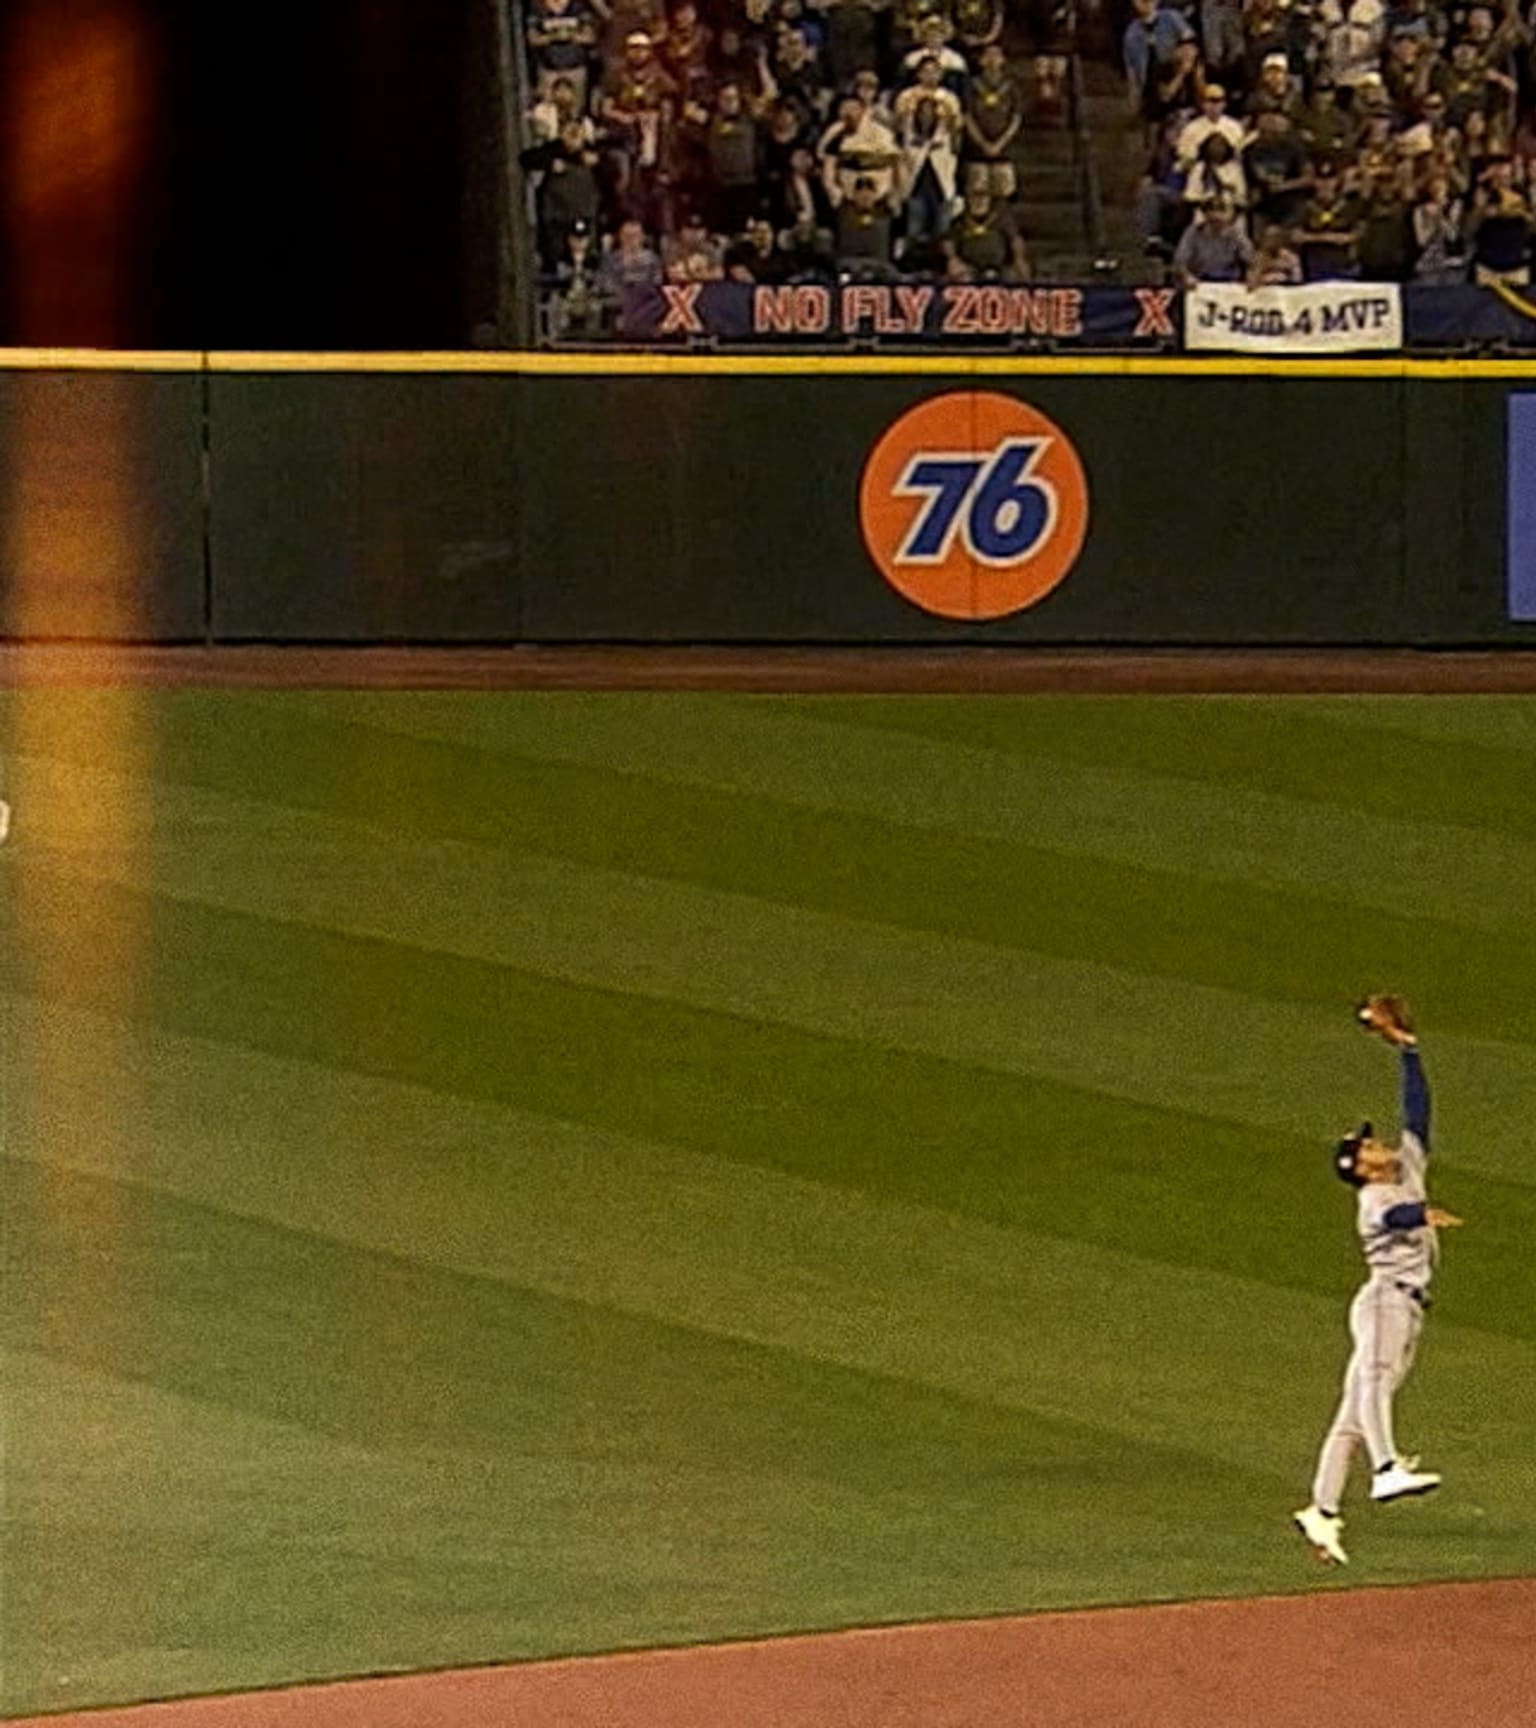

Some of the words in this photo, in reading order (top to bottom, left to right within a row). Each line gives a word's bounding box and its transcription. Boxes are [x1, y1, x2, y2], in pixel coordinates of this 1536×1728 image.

[661, 285, 702, 333] X
[754, 285, 829, 333] NO
[842, 285, 932, 333] FLY
[943, 286, 1082, 335] ZONE
[1134, 289, 1176, 336] X
[1294, 309, 1312, 335] 4
[1320, 298, 1390, 331] MVP
[890, 435, 1056, 569] 76
